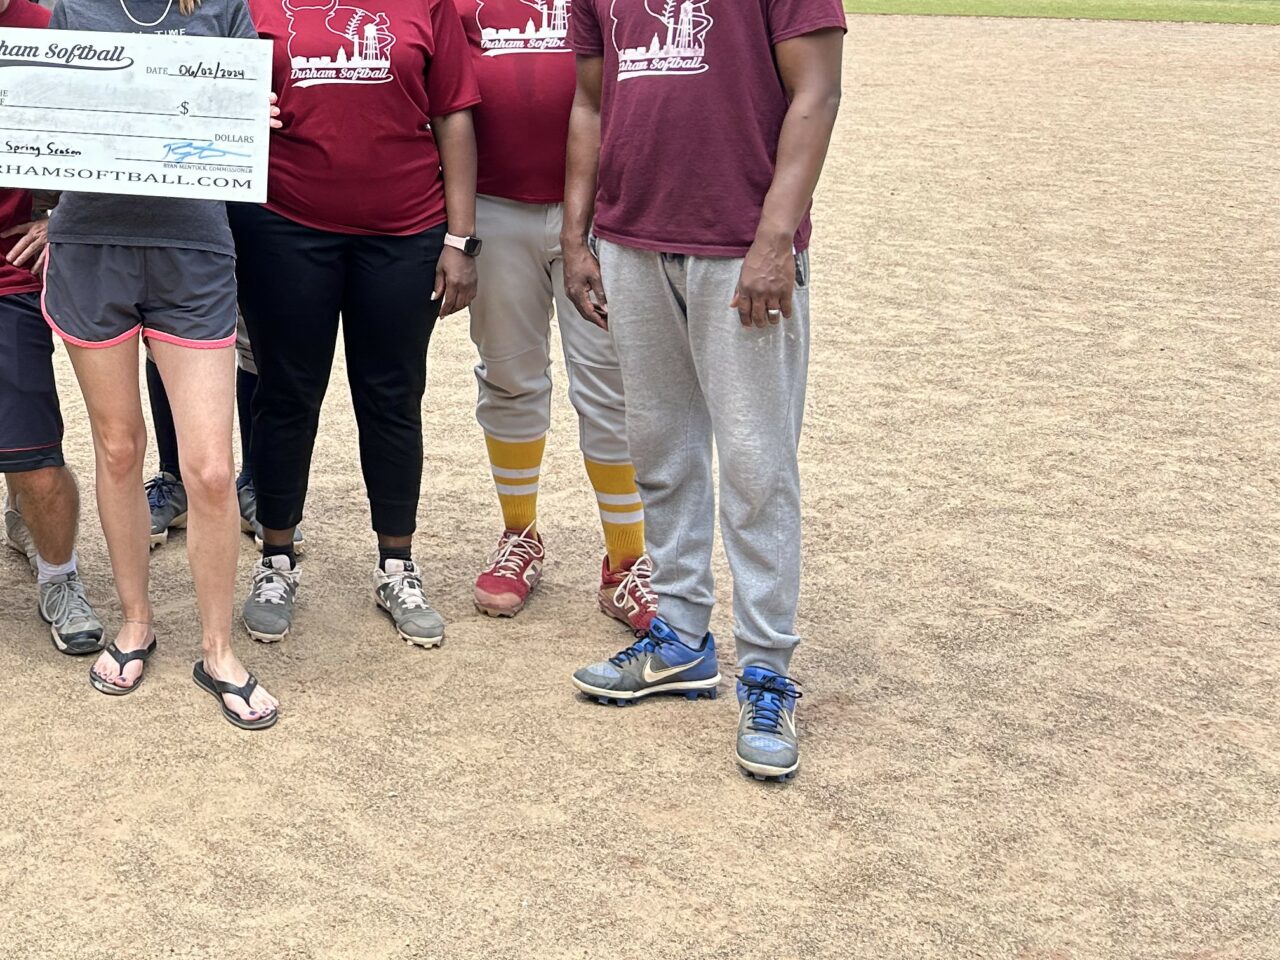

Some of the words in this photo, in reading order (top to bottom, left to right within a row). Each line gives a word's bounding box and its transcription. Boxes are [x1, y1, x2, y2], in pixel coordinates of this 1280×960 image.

[45, 43, 129, 64] Softball
[145, 66, 169, 75] DATE
[178, 61, 245, 80] 06/02/2024
[650, 56, 705, 71] Softball
[291, 68, 336, 79] Durham
[339, 67, 390, 81] Softball
[179, 100, 190, 116] $
[214, 133, 255, 144] DOLLARS
[5, 140, 41, 157] Spring
[46, 142, 82, 155] Season
